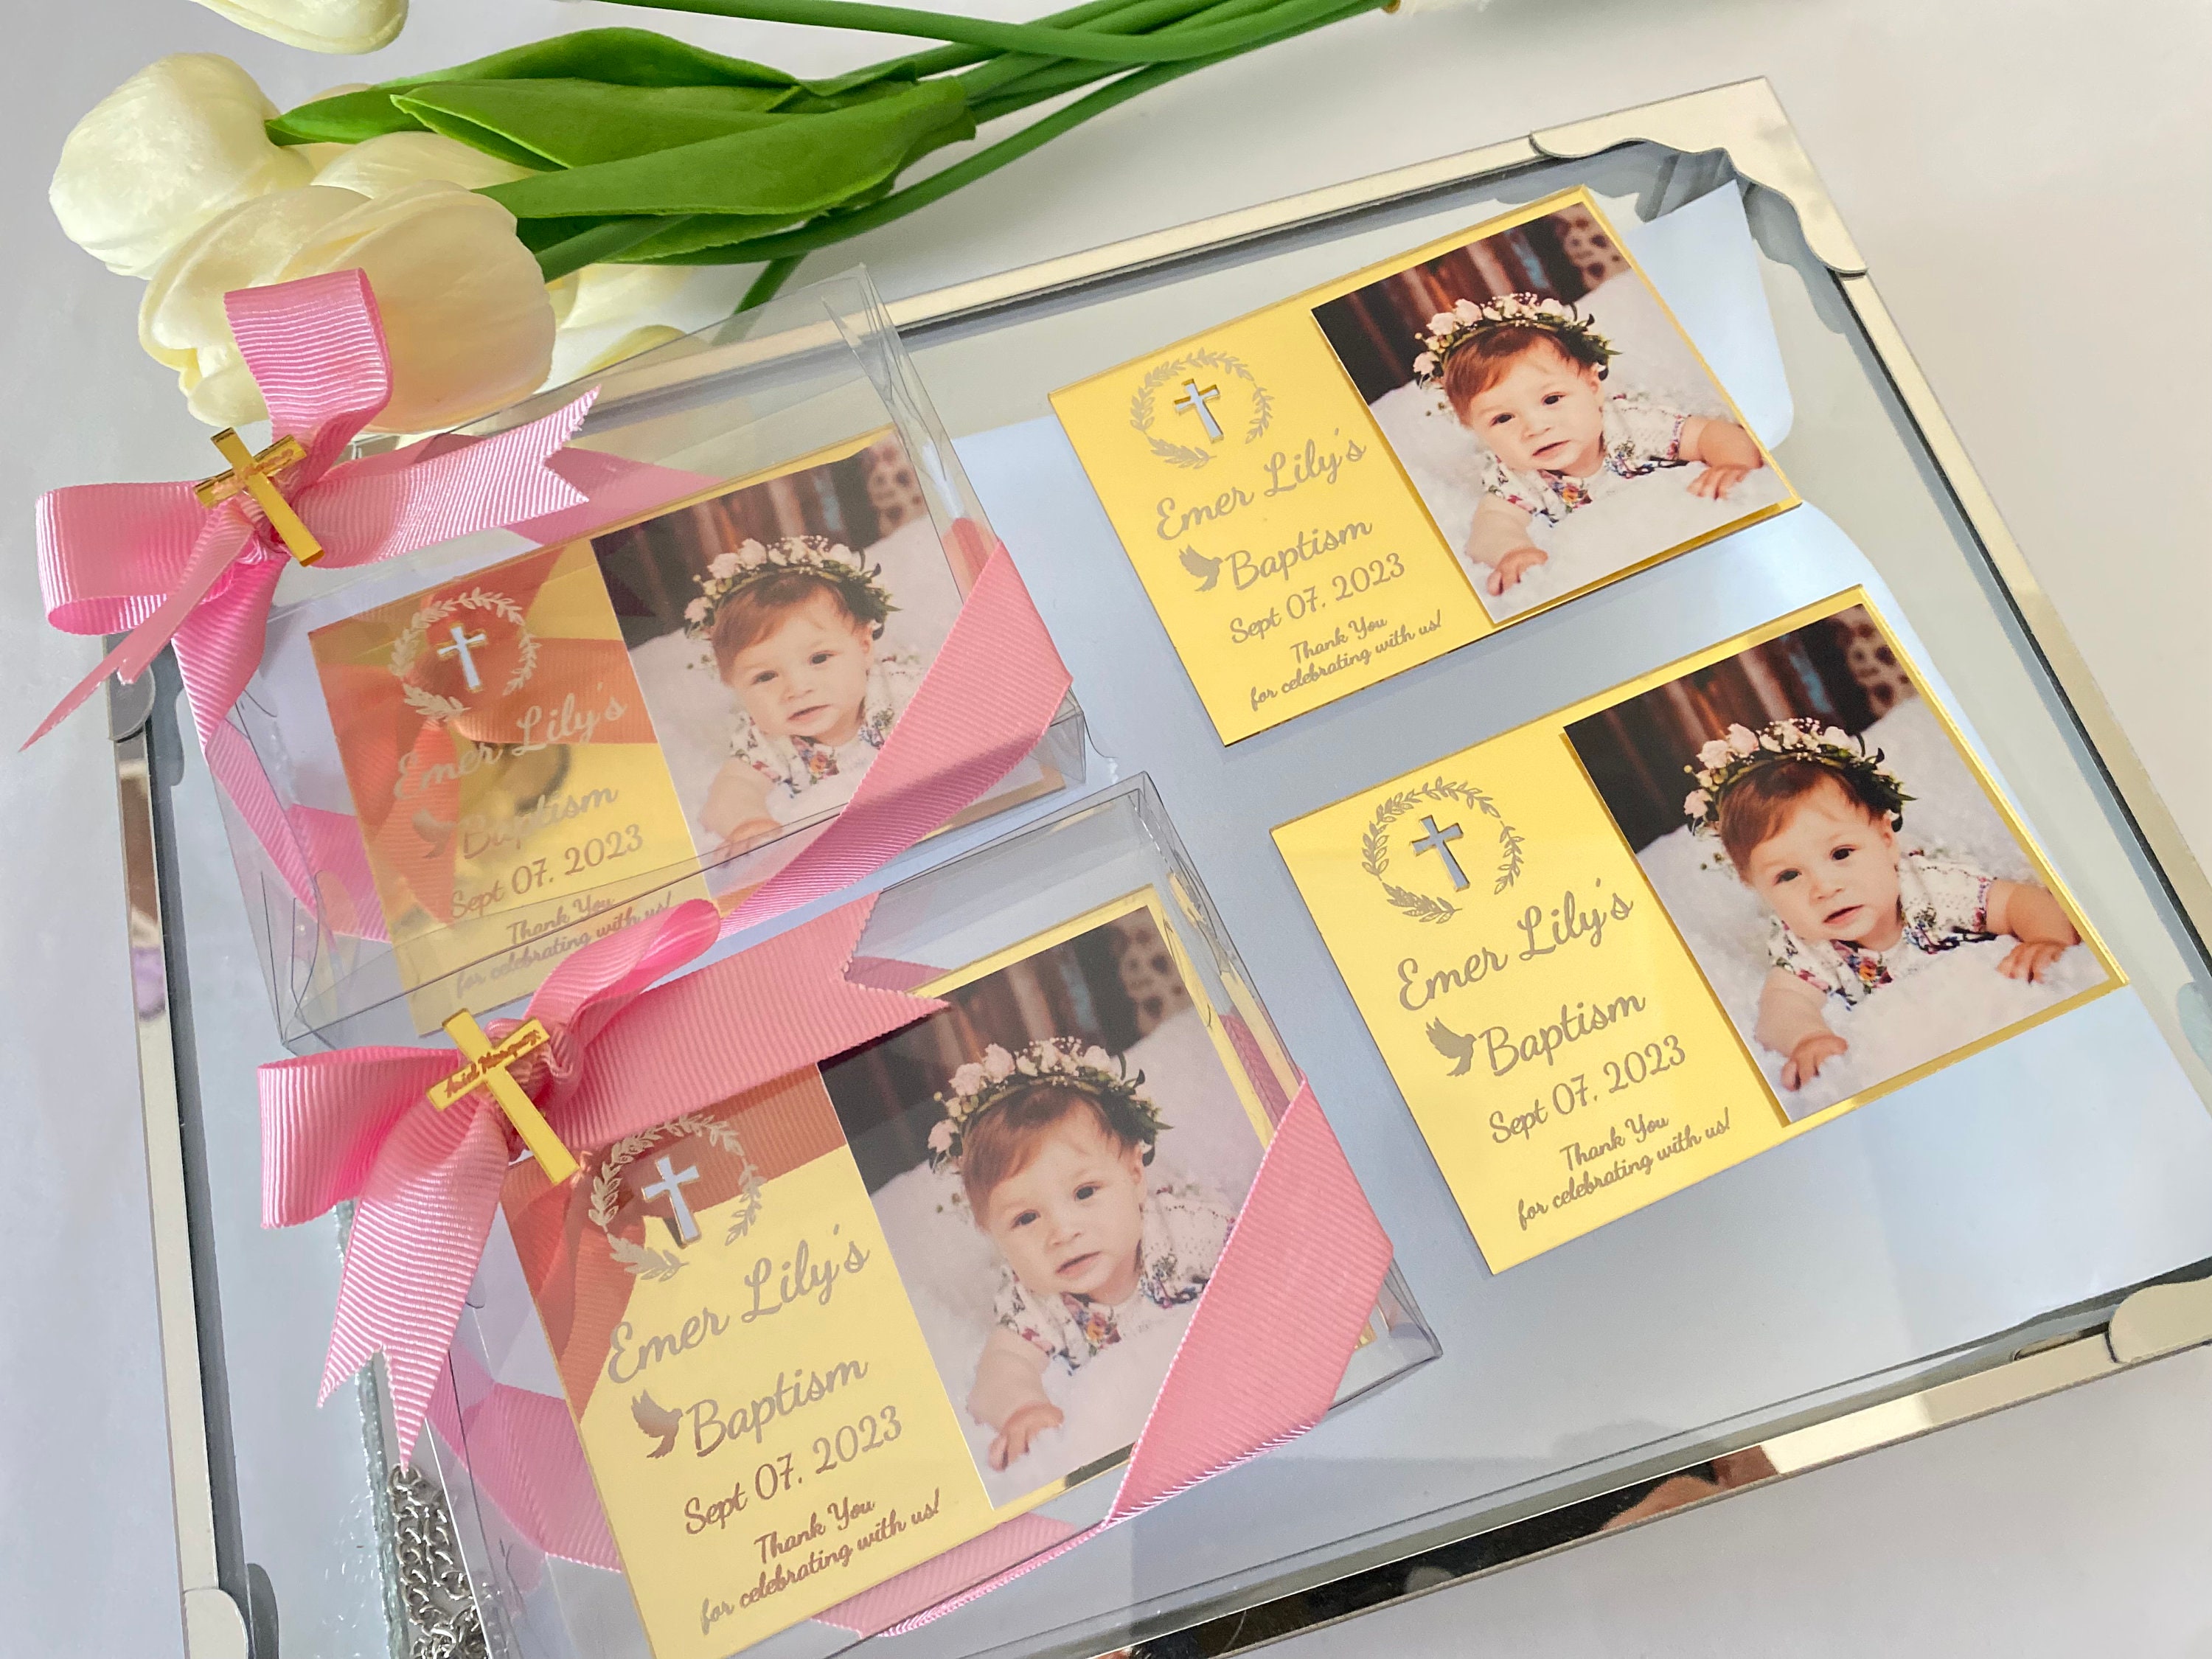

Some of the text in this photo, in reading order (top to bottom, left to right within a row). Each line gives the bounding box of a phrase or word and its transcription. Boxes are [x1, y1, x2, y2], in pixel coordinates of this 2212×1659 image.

[1156, 428, 1366, 540] Emer Lily's
[1225, 521, 1372, 591] Baptism
[1230, 608, 1281, 644] Sept
[1332, 553, 1405, 602] 2023
[1251, 610, 1441, 711] for celebrating with us!
[1290, 615, 1387, 663] Thank You
[394, 682, 627, 800] Emer Lily's
[451, 880, 504, 919] Sept
[564, 824, 644, 876] 2023
[507, 905, 570, 944] Thank
[596, 906, 640, 937] with
[1397, 877, 1633, 1010] Emer Lily's
[1478, 995, 1646, 1076] Baptism
[1489, 1099, 1547, 1144] Sept
[1604, 1034, 1685, 1093] 2023
[1518, 1107, 1730, 1231] for celebrating with us!
[1559, 1114, 1669, 1171] Thank You
[608, 1224, 870, 1383] Emer Lily's
[686, 1357, 869, 1456] Baptism
[684, 1482, 748, 1535] Sept
[813, 1405, 902, 1474] 2023
[701, 1487, 941, 1635] for celebrating with us!
[754, 1497, 875, 1564] Thank You
